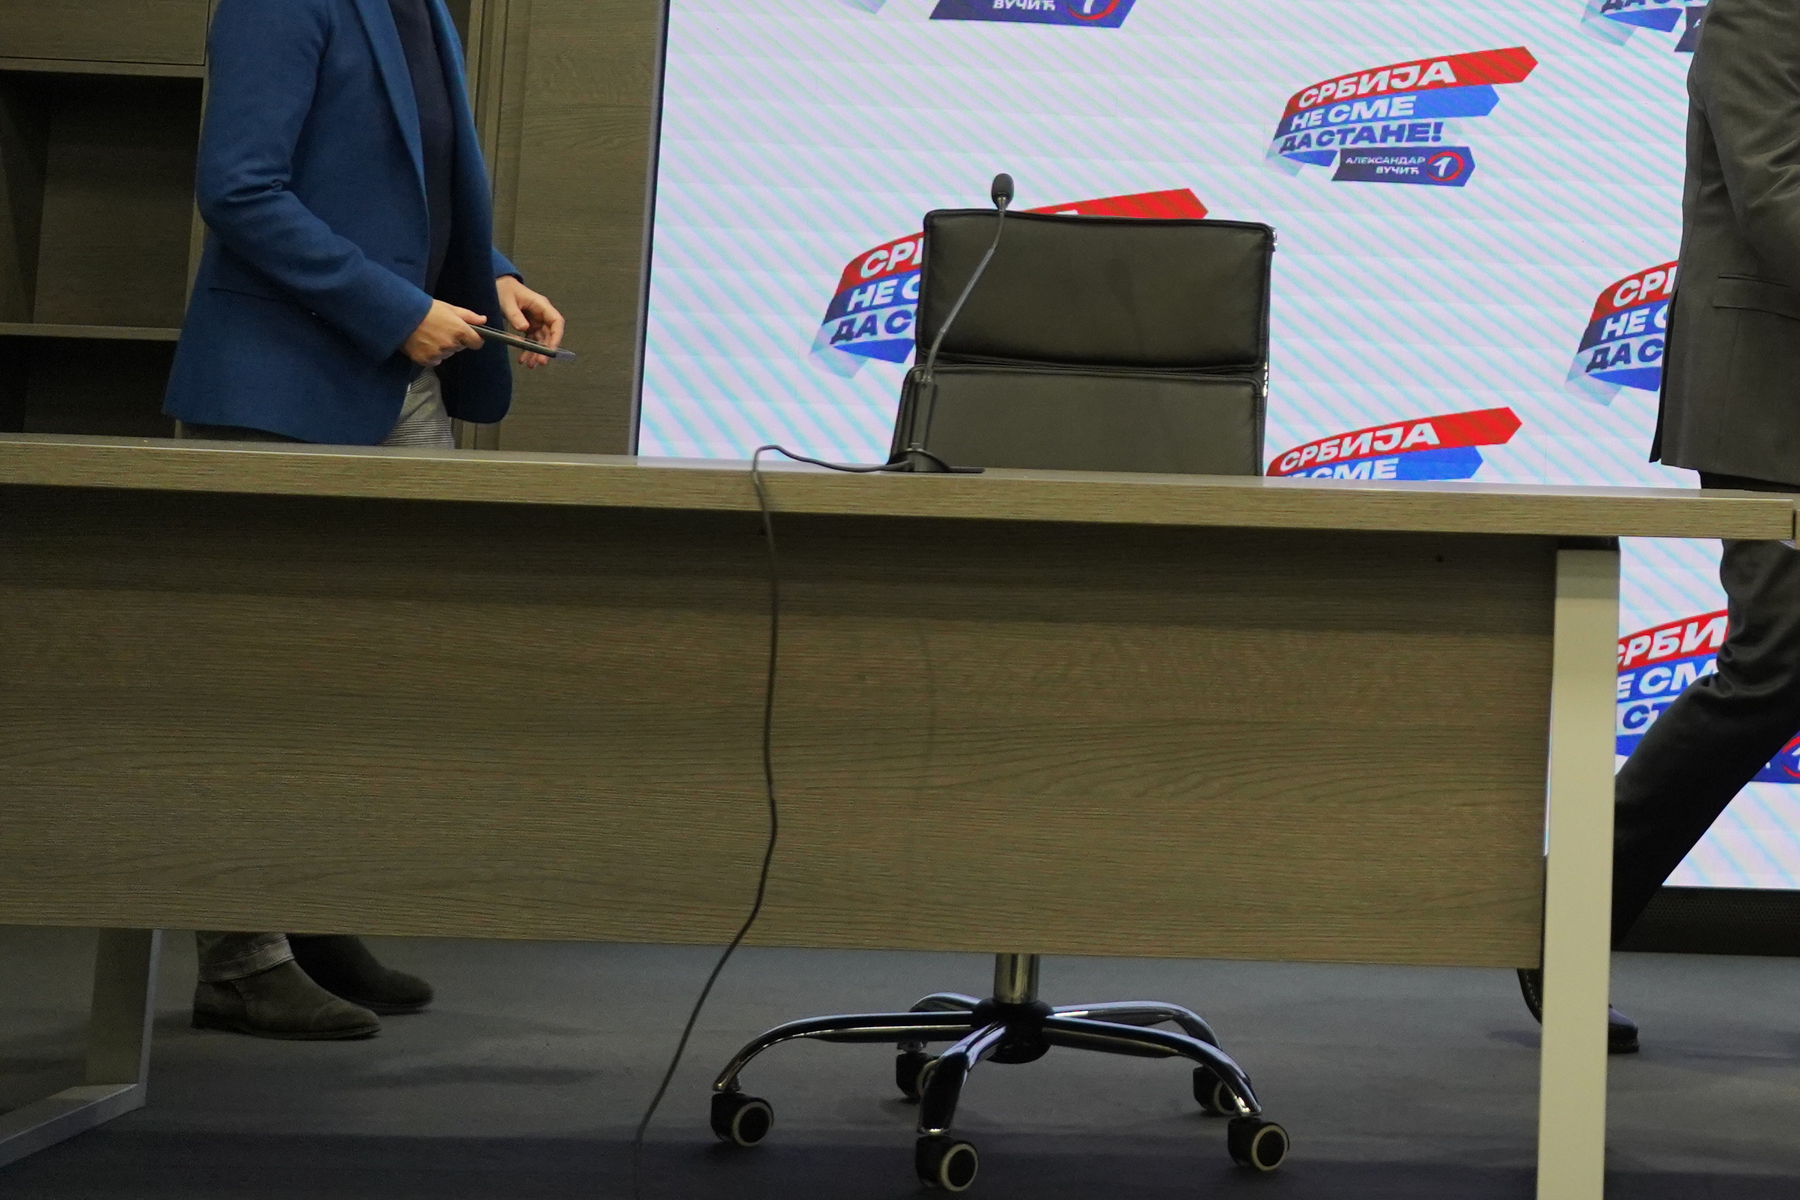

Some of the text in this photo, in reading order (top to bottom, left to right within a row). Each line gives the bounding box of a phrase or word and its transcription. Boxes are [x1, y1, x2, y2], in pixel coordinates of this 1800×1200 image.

[1298, 61, 1456, 108] СРБИЈА
[1291, 96, 1417, 131] НЕ СМЕ
[1279, 122, 1444, 154] ДА СТАНЕ!
[1433, 157, 1451, 177] 1
[847, 279, 899, 312] НЕ
[829, 314, 878, 344] ДА
[1601, 308, 1650, 340] НЕ
[1585, 343, 1632, 373] ДА
[1280, 423, 1440, 472] СРБИЈА
